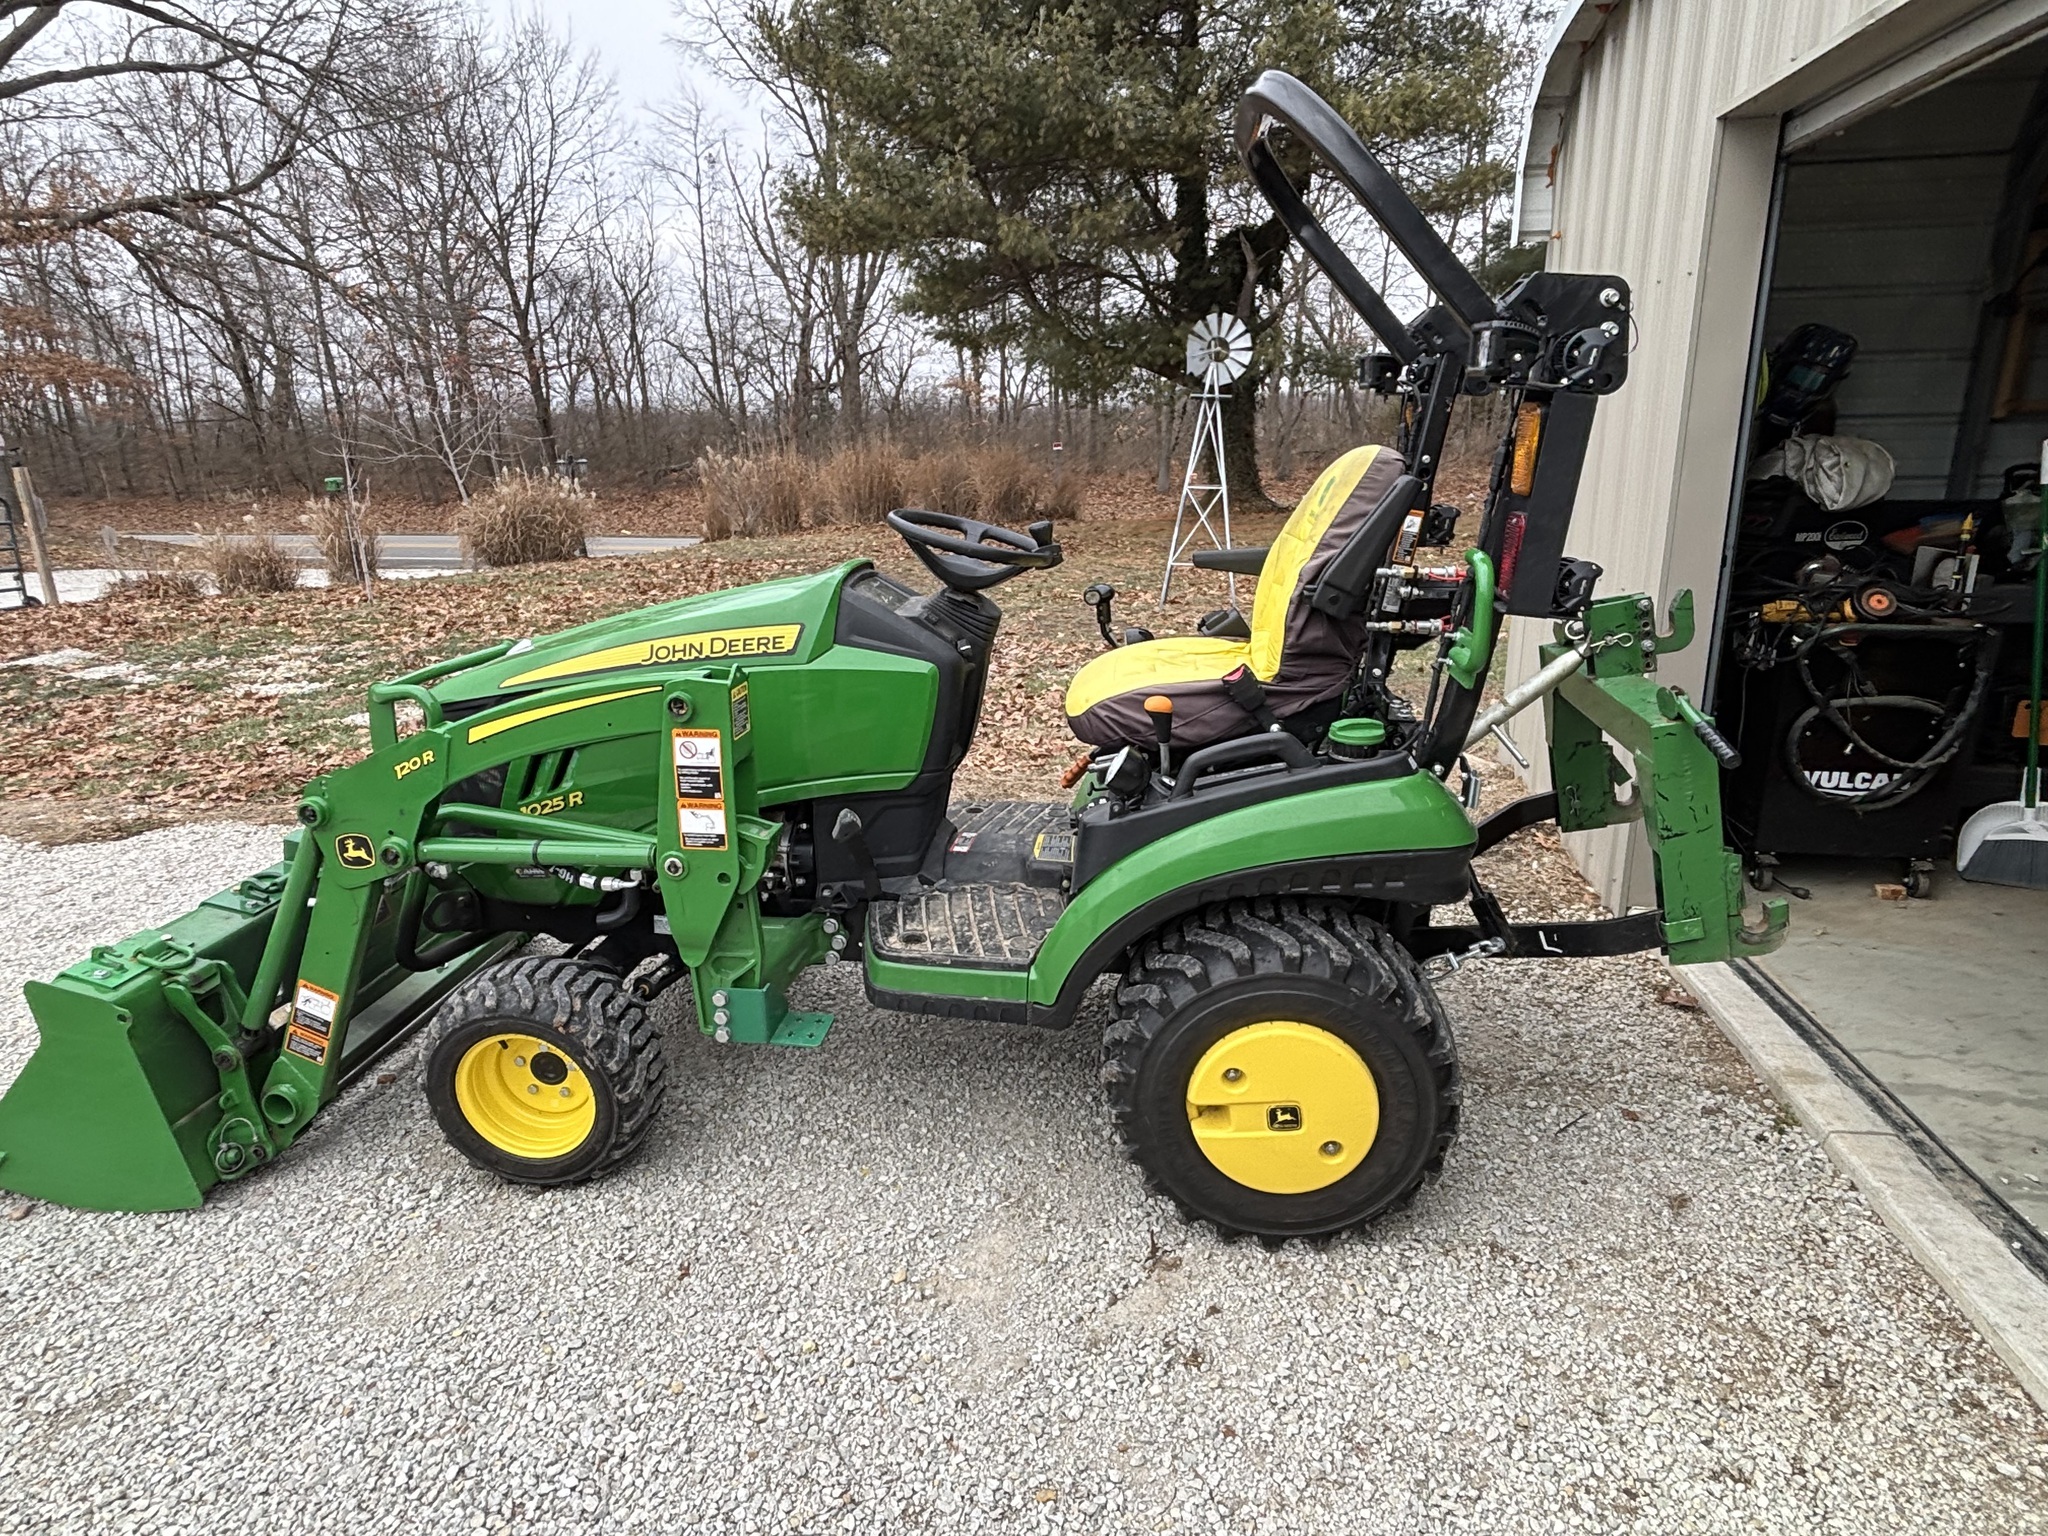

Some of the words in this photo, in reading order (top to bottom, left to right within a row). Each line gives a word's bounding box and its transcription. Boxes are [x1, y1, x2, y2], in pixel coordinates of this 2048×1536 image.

[642, 642, 704, 662] JOHN
[710, 636, 786, 655] DEERE
[394, 757, 421, 780] 120
[422, 750, 435, 765] R
[568, 791, 584, 807] R
